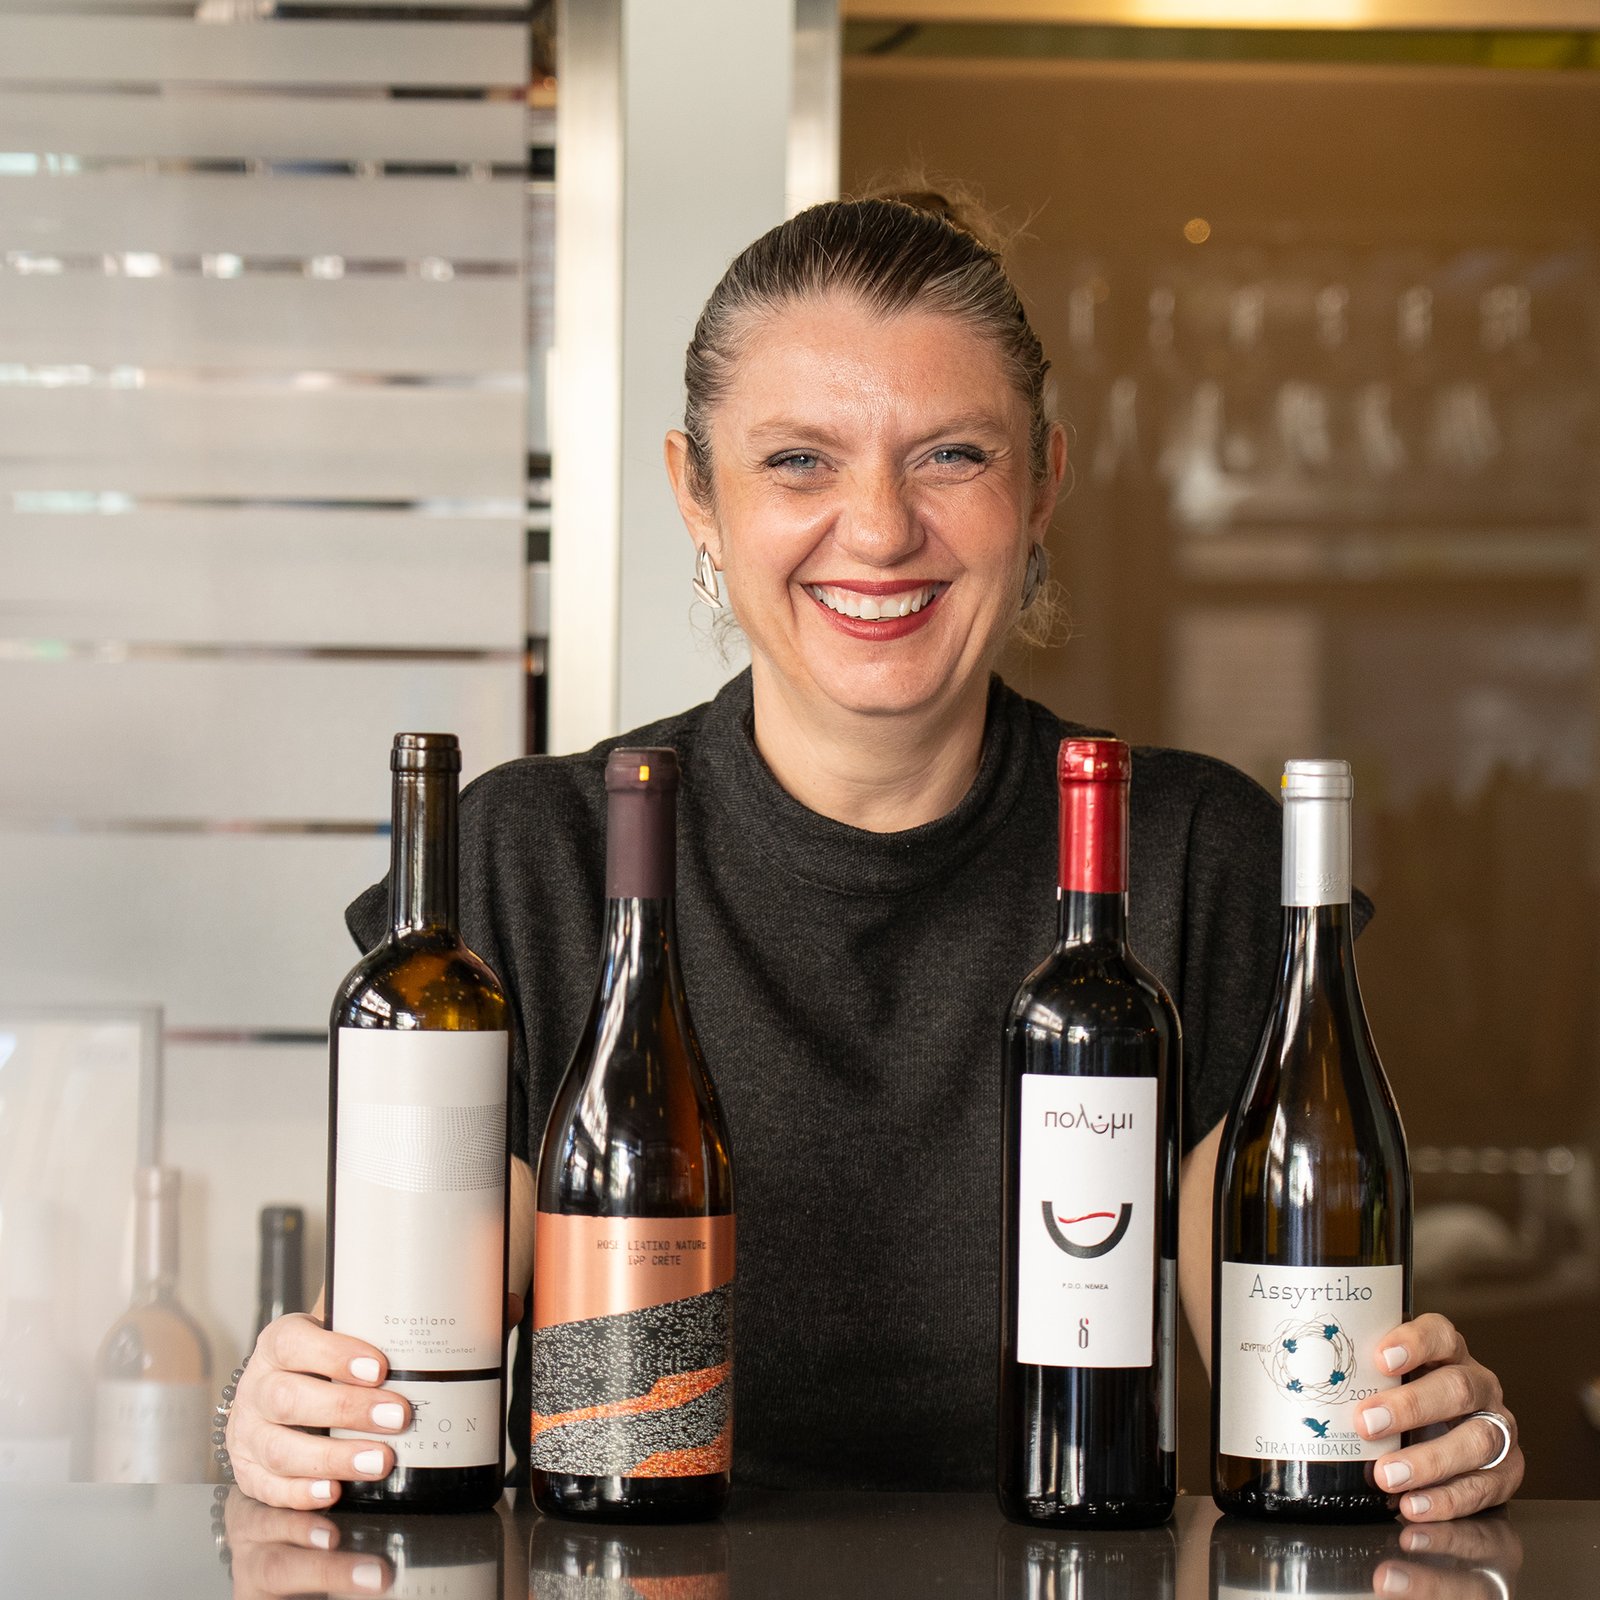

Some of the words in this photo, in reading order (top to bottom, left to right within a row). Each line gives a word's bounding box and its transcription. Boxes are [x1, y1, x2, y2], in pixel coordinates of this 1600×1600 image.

[627, 1240, 670, 1250] LIATIKO
[627, 1255, 645, 1266] IGP
[1249, 1274, 1372, 1308] Assyrtiko
[384, 1315, 456, 1326] Savatiano
[409, 1329, 431, 1337] 2023
[411, 1418, 476, 1432] TON
[1330, 1431, 1359, 1439] WINERY
